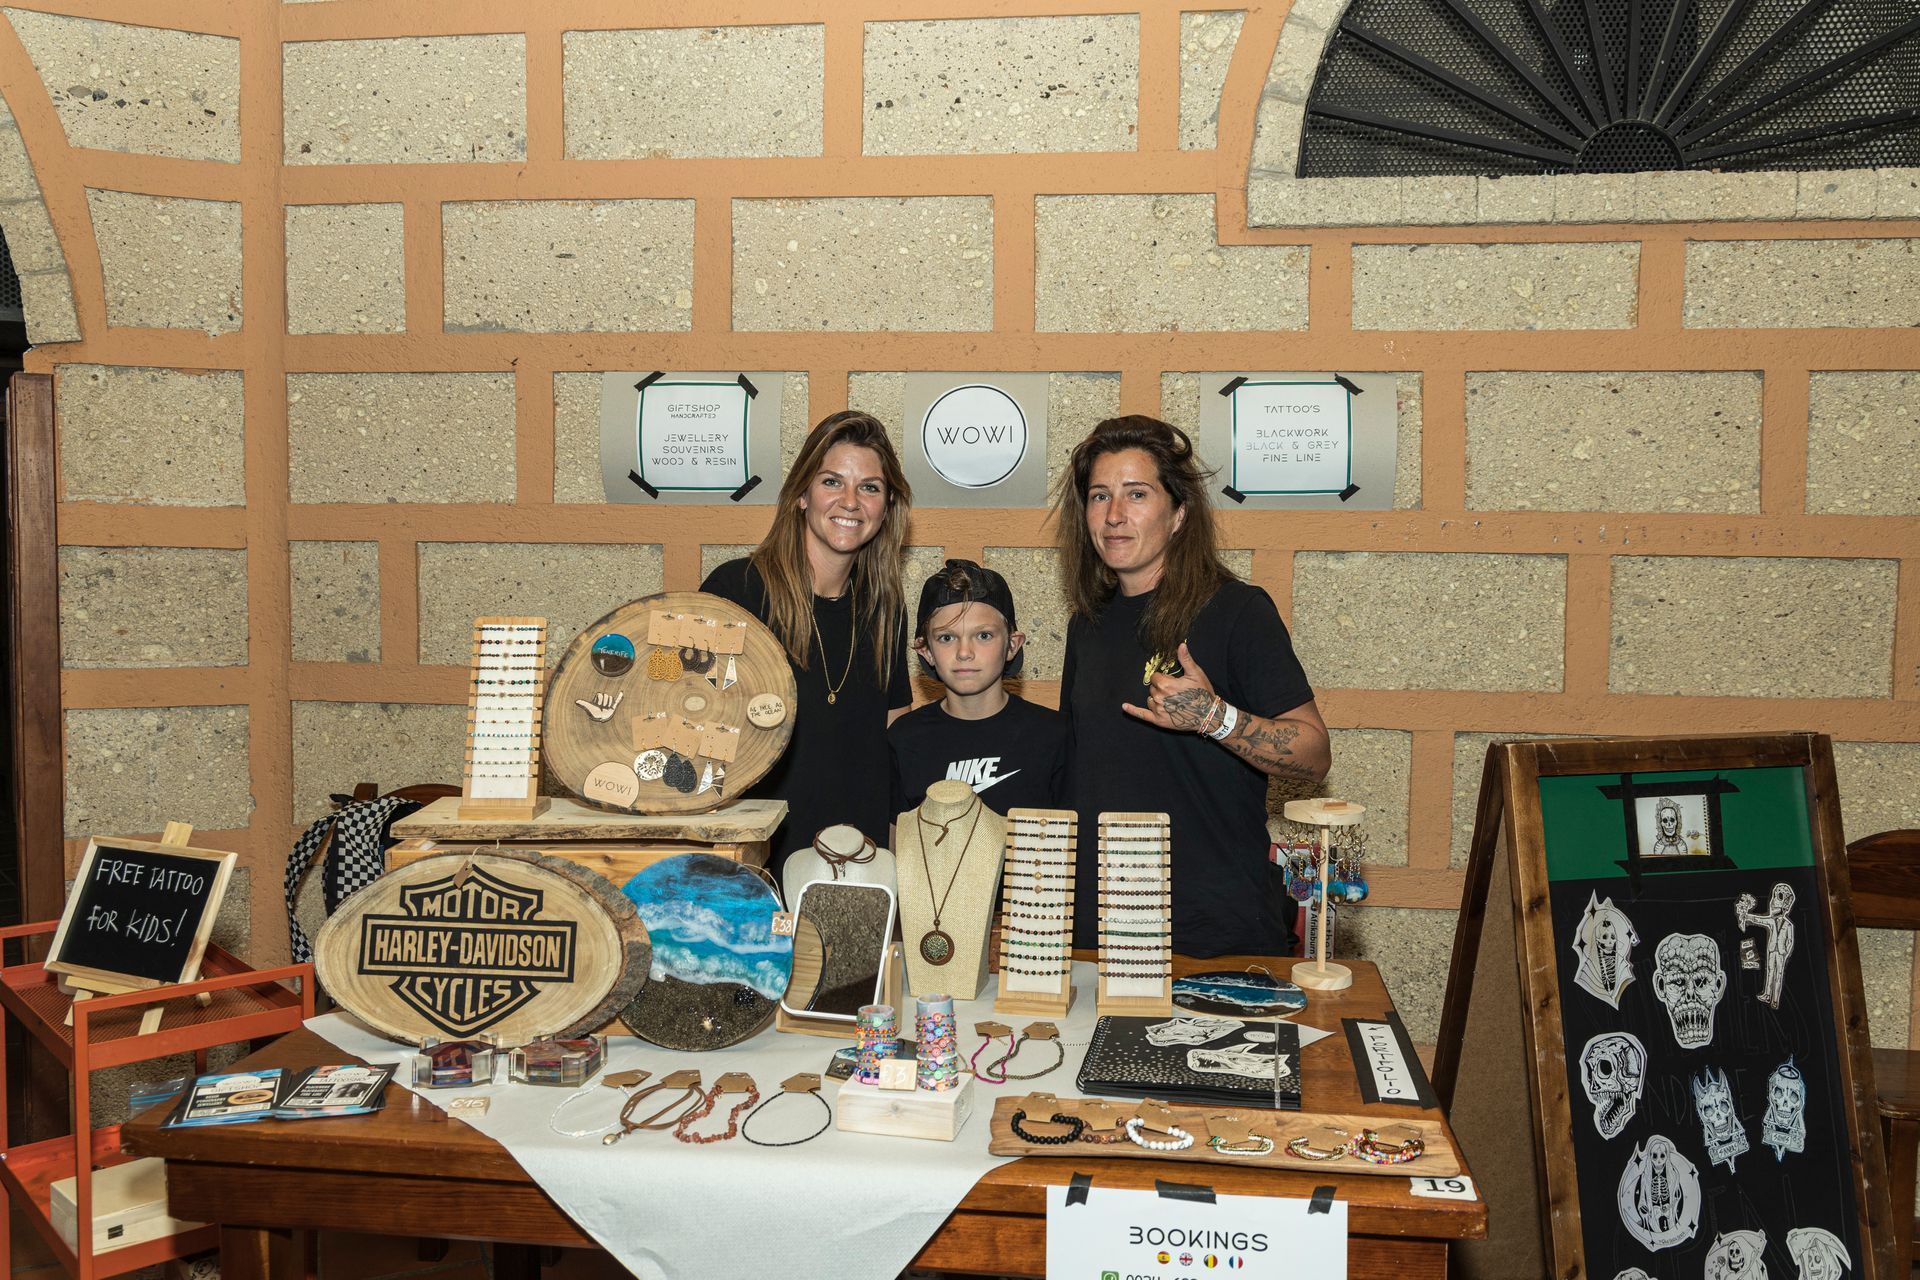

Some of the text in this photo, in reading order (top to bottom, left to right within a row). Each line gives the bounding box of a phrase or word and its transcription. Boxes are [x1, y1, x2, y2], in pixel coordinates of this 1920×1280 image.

[667, 404, 721, 413] GIFTSHOP
[1263, 404, 1321, 414] TATTOO'S
[664, 433, 729, 443] JEWELLERY
[1256, 428, 1329, 438] BLACKWORK
[662, 445, 725, 454] SOUVENIRS
[1245, 440, 1340, 451] BLACK & GREY
[651, 457, 737, 466] WOOD & RESIN
[1262, 453, 1321, 463] FINE LINE
[945, 756, 1002, 785] NIKE
[96, 858, 204, 896] FREE TATTOO
[421, 884, 521, 921] MOTOR
[87, 905, 119, 932] FOR
[771, 916, 792, 933] €38
[1310, 913, 1319, 955] Afrikaburn
[374, 928, 562, 969] HARLEY-DAVIDSON
[414, 975, 512, 1021] CYCLES
[1424, 1179, 1467, 1193] 19
[1129, 1226, 1269, 1252] BOOKINGS
